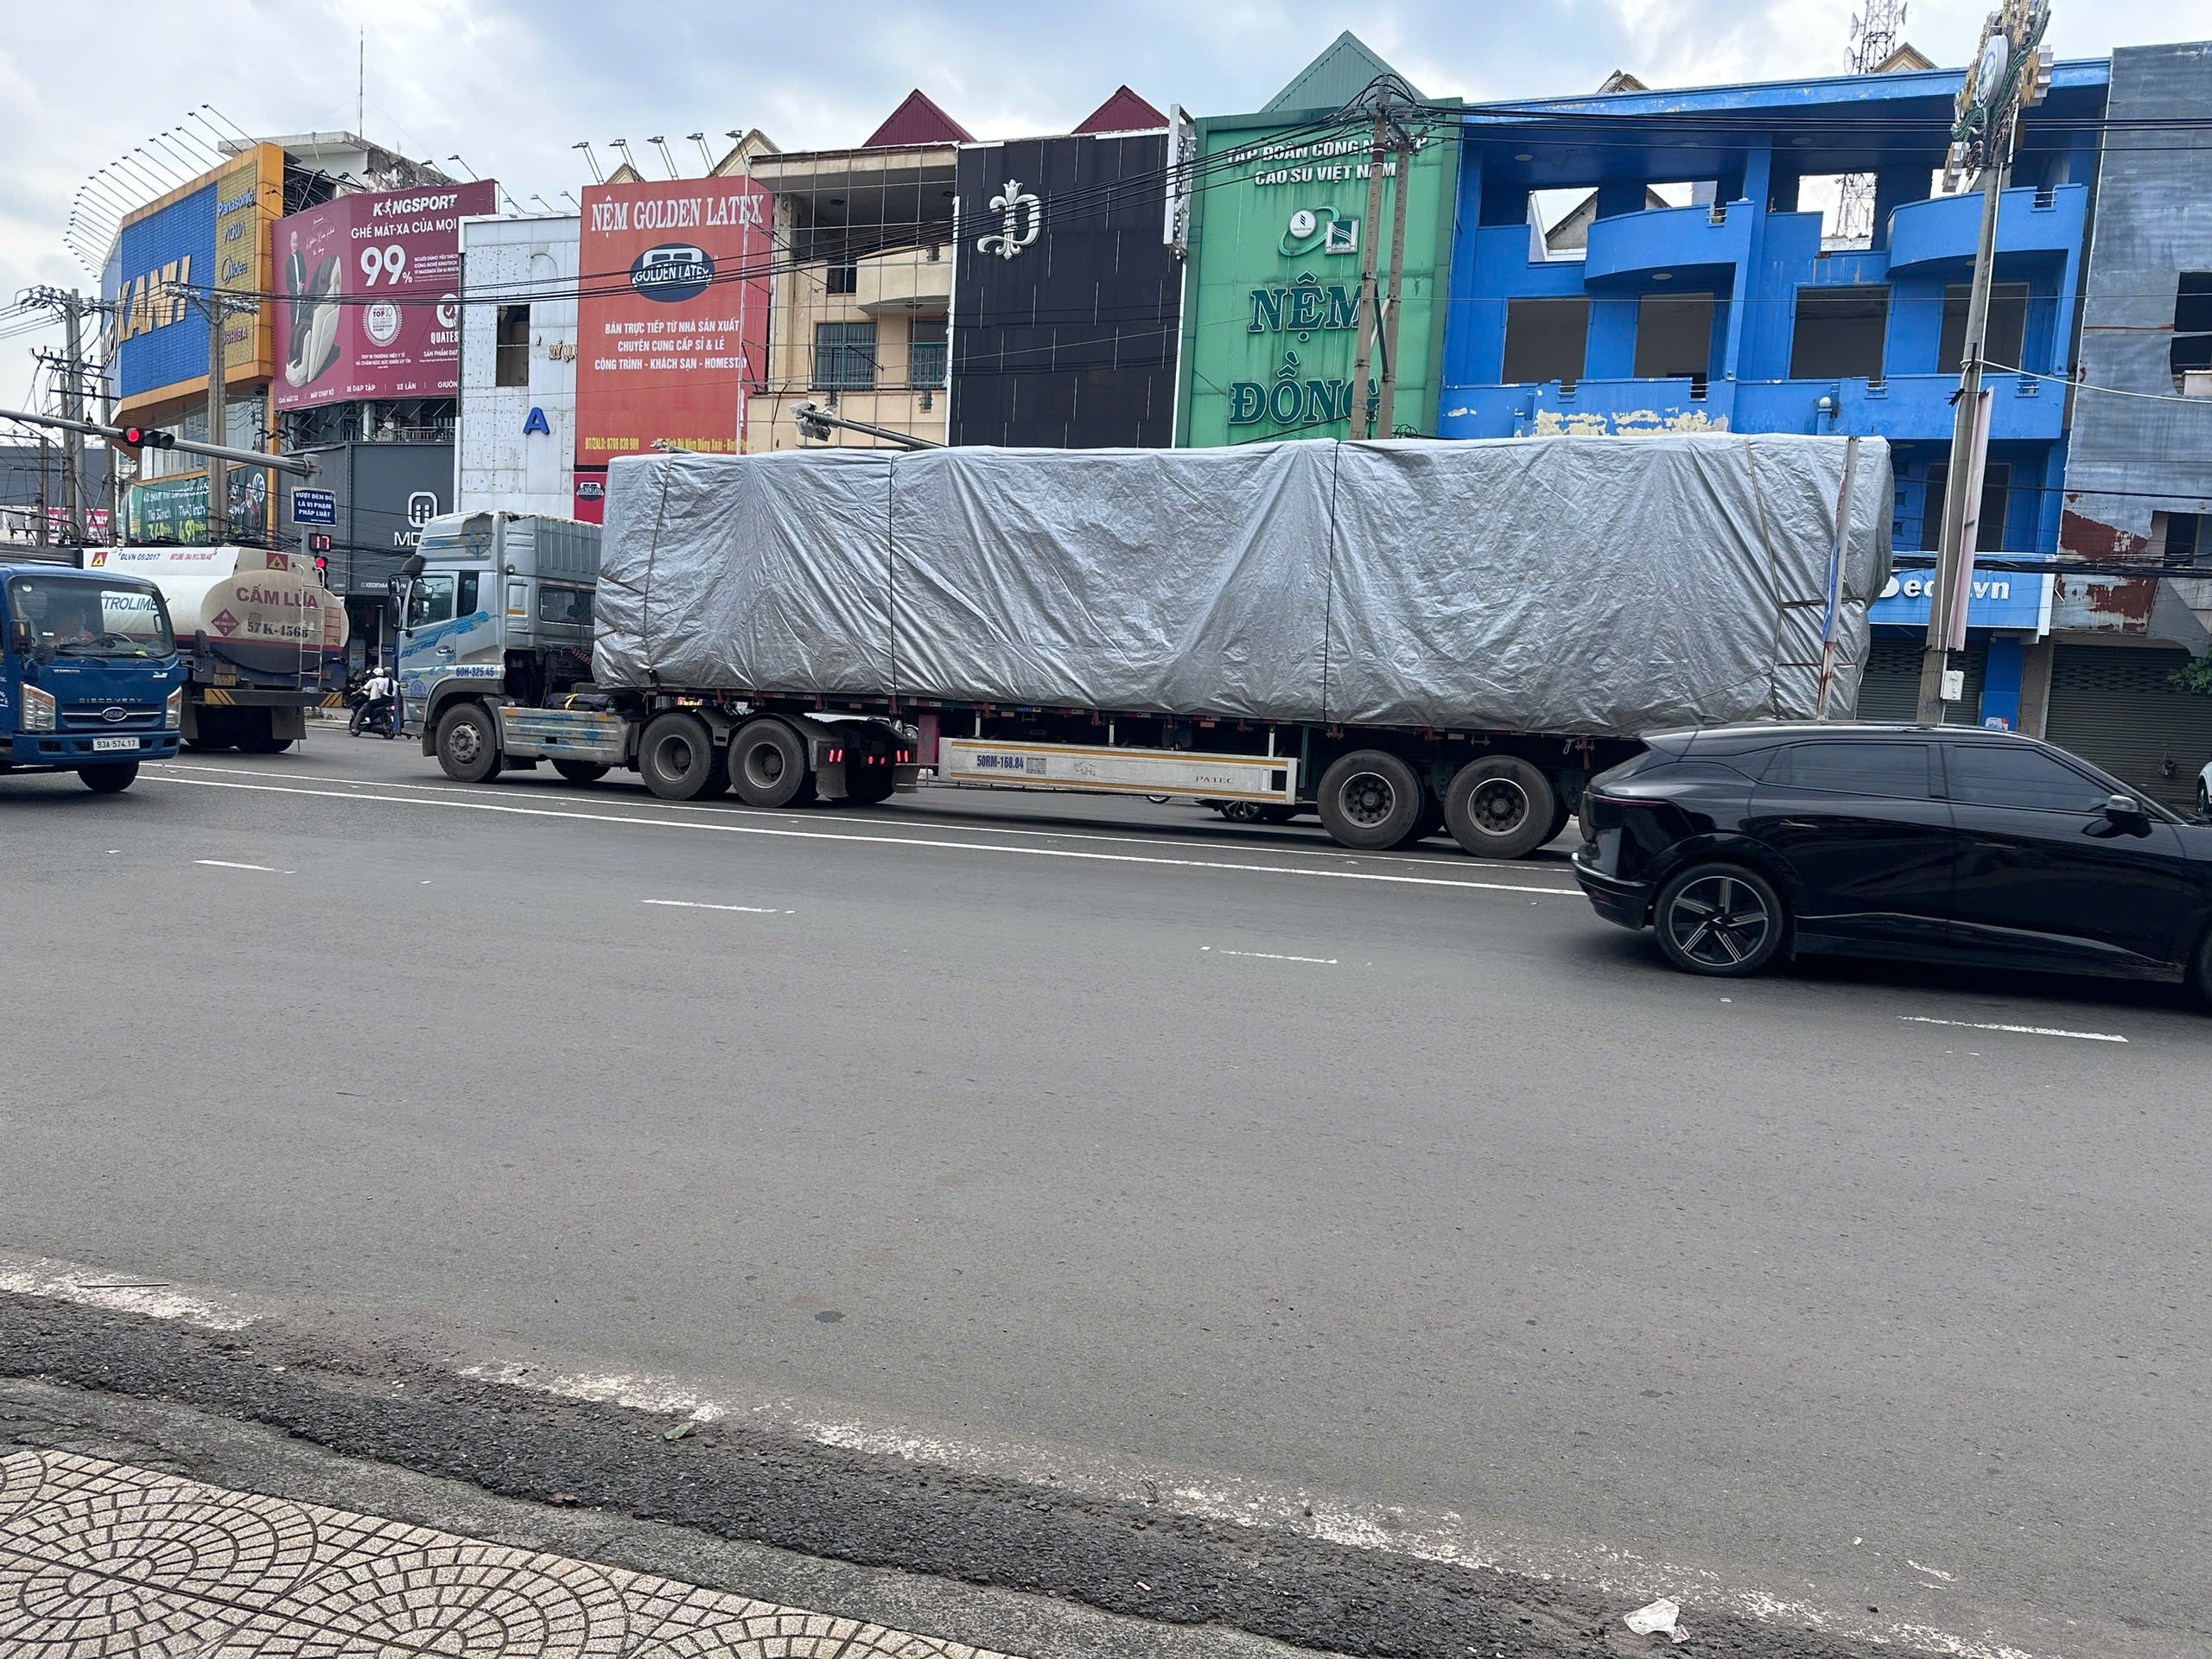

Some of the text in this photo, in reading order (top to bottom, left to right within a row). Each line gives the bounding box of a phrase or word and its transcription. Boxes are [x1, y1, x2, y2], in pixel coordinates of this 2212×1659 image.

[1312, 138, 1358, 156] CÔNG
[1255, 170, 1288, 186] CAO
[1290, 167, 1313, 183] SU
[1317, 162, 1353, 183] VIỆT
[218, 189, 254, 218] Panasonic
[591, 194, 764, 238] NỆM GOLDEN LATEX
[351, 223, 372, 238] GHẾ
[374, 222, 410, 237] MÁT-XA
[412, 218, 433, 233] CỦA
[436, 218, 456, 233] MỌI
[635, 264, 711, 283] GOLDEN LATEX
[1248, 270, 1363, 342] NỆM
[624, 321, 645, 337] TRỰC
[647, 318, 664, 335] TIẾP
[666, 319, 677, 333] TỪ
[679, 319, 696, 333] NHÀ
[698, 317, 715, 332] SẢN
[717, 315, 741, 332] XUẤT
[224, 327, 248, 345] SHIBA
[617, 339, 650, 353] CHUYÊN
[652, 340, 674, 352] CUNG
[676, 335, 693, 351] CẤP
[706, 340, 714, 350] &
[715, 334, 725, 350] LẺ
[594, 355, 617, 371] CÔNG
[619, 355, 643, 370] TRÌNH
[650, 355, 677, 370] KHÁCH
[679, 357, 697, 372] SẠN
[704, 354, 747, 369] HOMESTAY
[1229, 350, 1380, 425] ĐỒNG
[523, 407, 550, 435] A
[316, 536, 330, 550] 17
[236, 584, 319, 607] CẤM LỬA
[456, 667, 494, 677] 60H-325.45
[97, 740, 136, 748] 93A-574.17
[976, 754, 1024, 769] 50RM-168.84
[1196, 775, 1236, 785] PATEC
